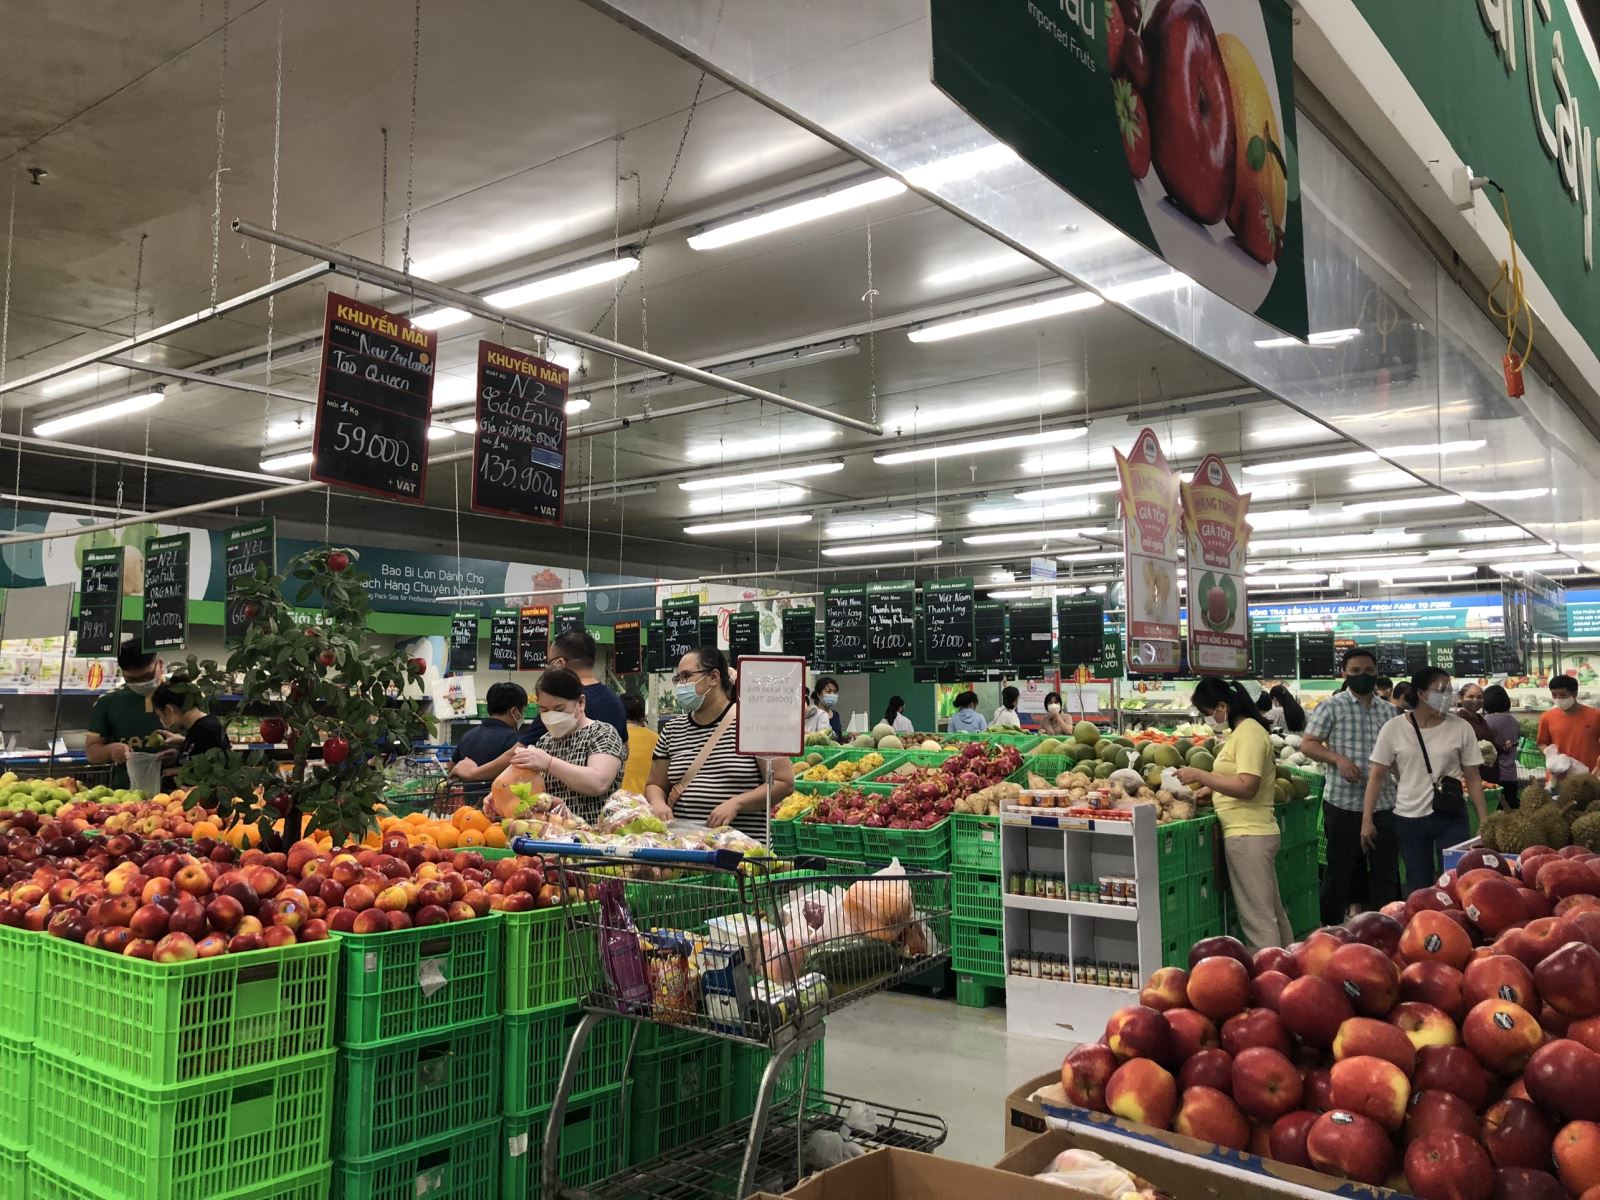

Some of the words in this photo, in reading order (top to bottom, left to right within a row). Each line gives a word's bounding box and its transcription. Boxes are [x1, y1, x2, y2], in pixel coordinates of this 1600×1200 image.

[1028, 0, 1068, 47] Imported
[1070, 36, 1096, 72] Fruits
[337, 304, 398, 336] KHUYẾN
[402, 327, 428, 347] MÃI
[487, 350, 537, 377] KHUYẾN
[540, 367, 562, 385] MÃI
[365, 364, 410, 391] Queen
[480, 452, 553, 495] 135.900
[396, 479, 417, 493] VAT
[540, 505, 557, 517] VAT
[1140, 504, 1153, 521] GIÁ
[1201, 524, 1216, 537] GIÁ
[1216, 524, 1232, 541] TỐT
[381, 564, 401, 576] Bao
[466, 572, 485, 584] Cho
[384, 579, 410, 595] Hàng
[413, 581, 451, 596] Chuyên
[1338, 604, 1370, 613] QUALITY
[1371, 603, 1393, 612] FROM
[1230, 638, 1243, 647] XANH
